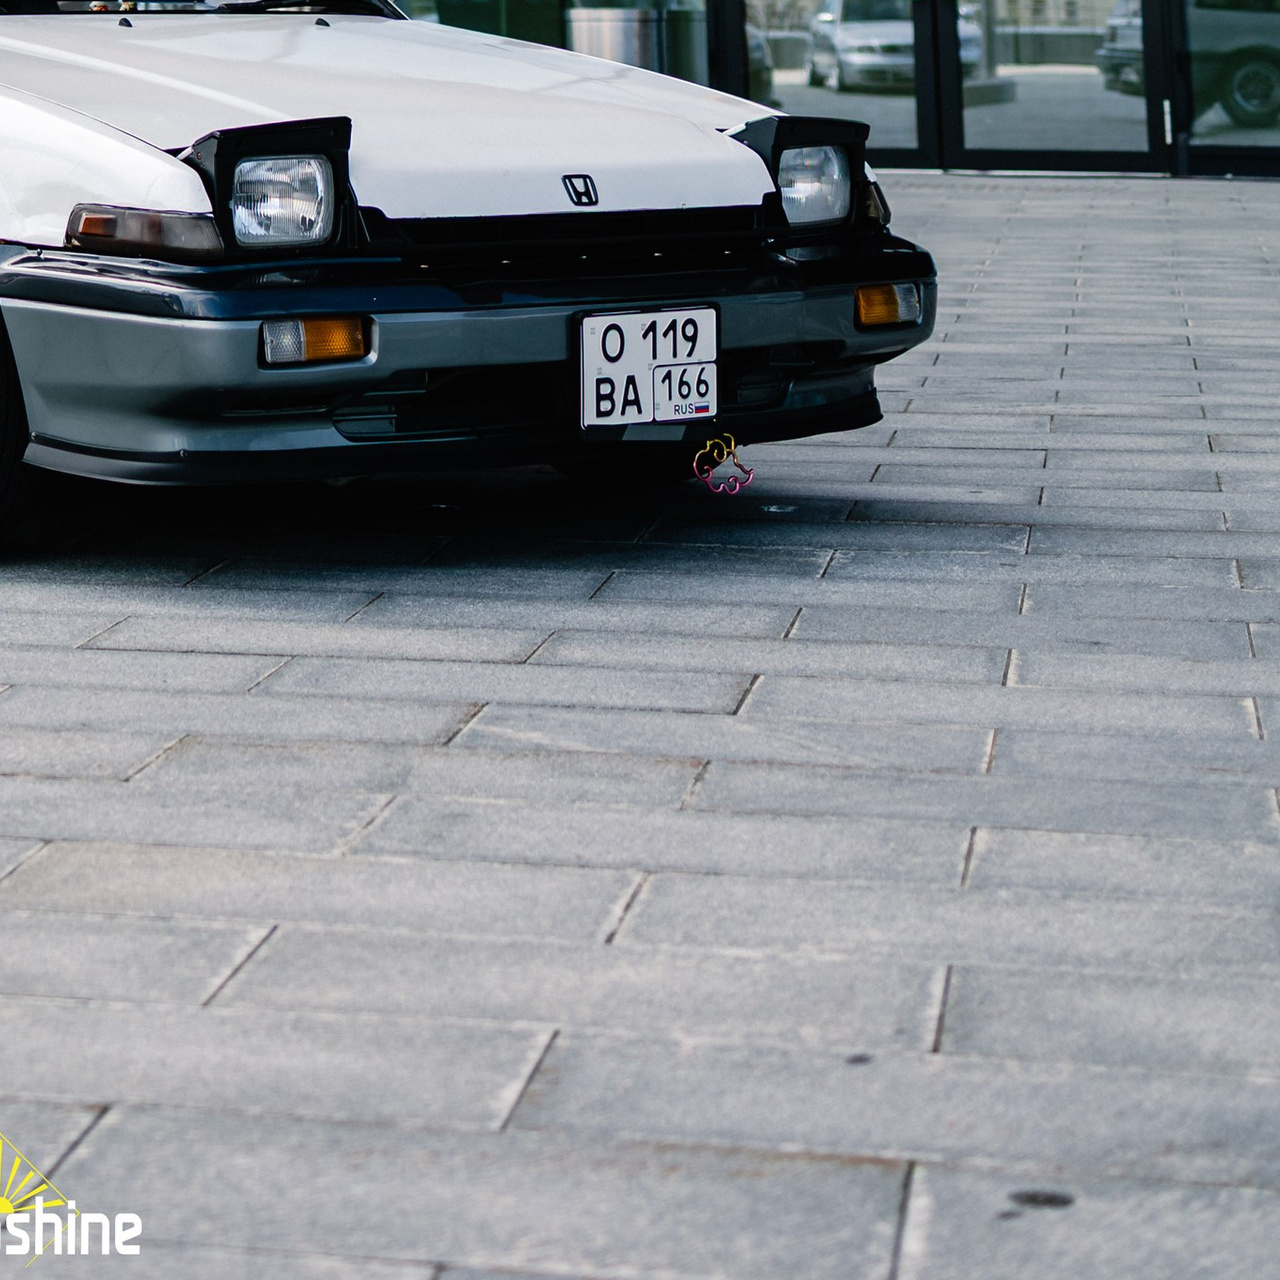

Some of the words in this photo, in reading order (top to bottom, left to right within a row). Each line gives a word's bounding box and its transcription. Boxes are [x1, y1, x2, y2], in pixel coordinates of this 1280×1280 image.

[642, 318, 699, 360] 119
[661, 367, 709, 402] 166
[674, 403, 694, 415] RUS
